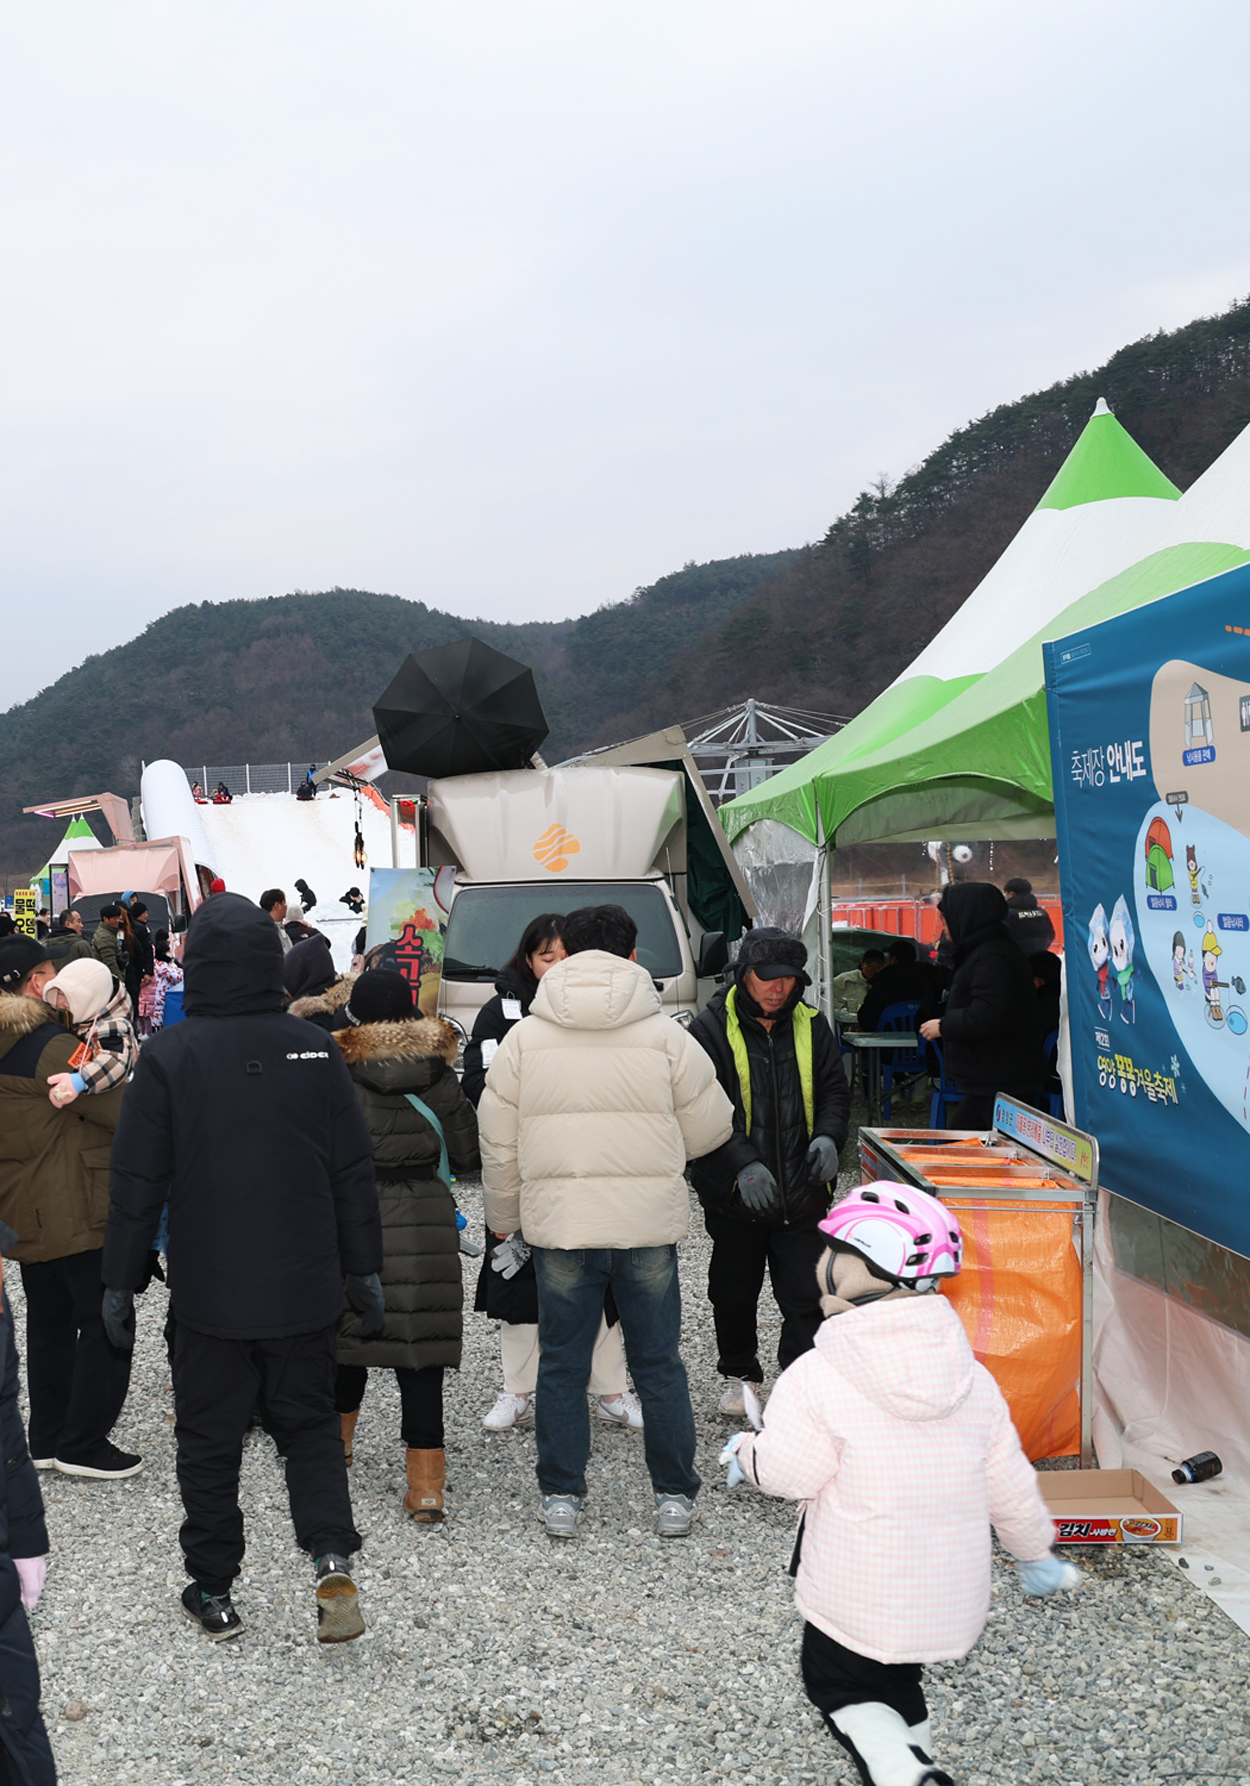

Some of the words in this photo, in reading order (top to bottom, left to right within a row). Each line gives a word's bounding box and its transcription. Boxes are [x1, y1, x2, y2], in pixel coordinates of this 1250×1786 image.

[1071, 746, 1105, 788] 축제장
[1106, 740, 1147, 784] 안내도
[395, 925, 423, 1006] 소고
[1059, 1522, 1092, 1538] 김치
